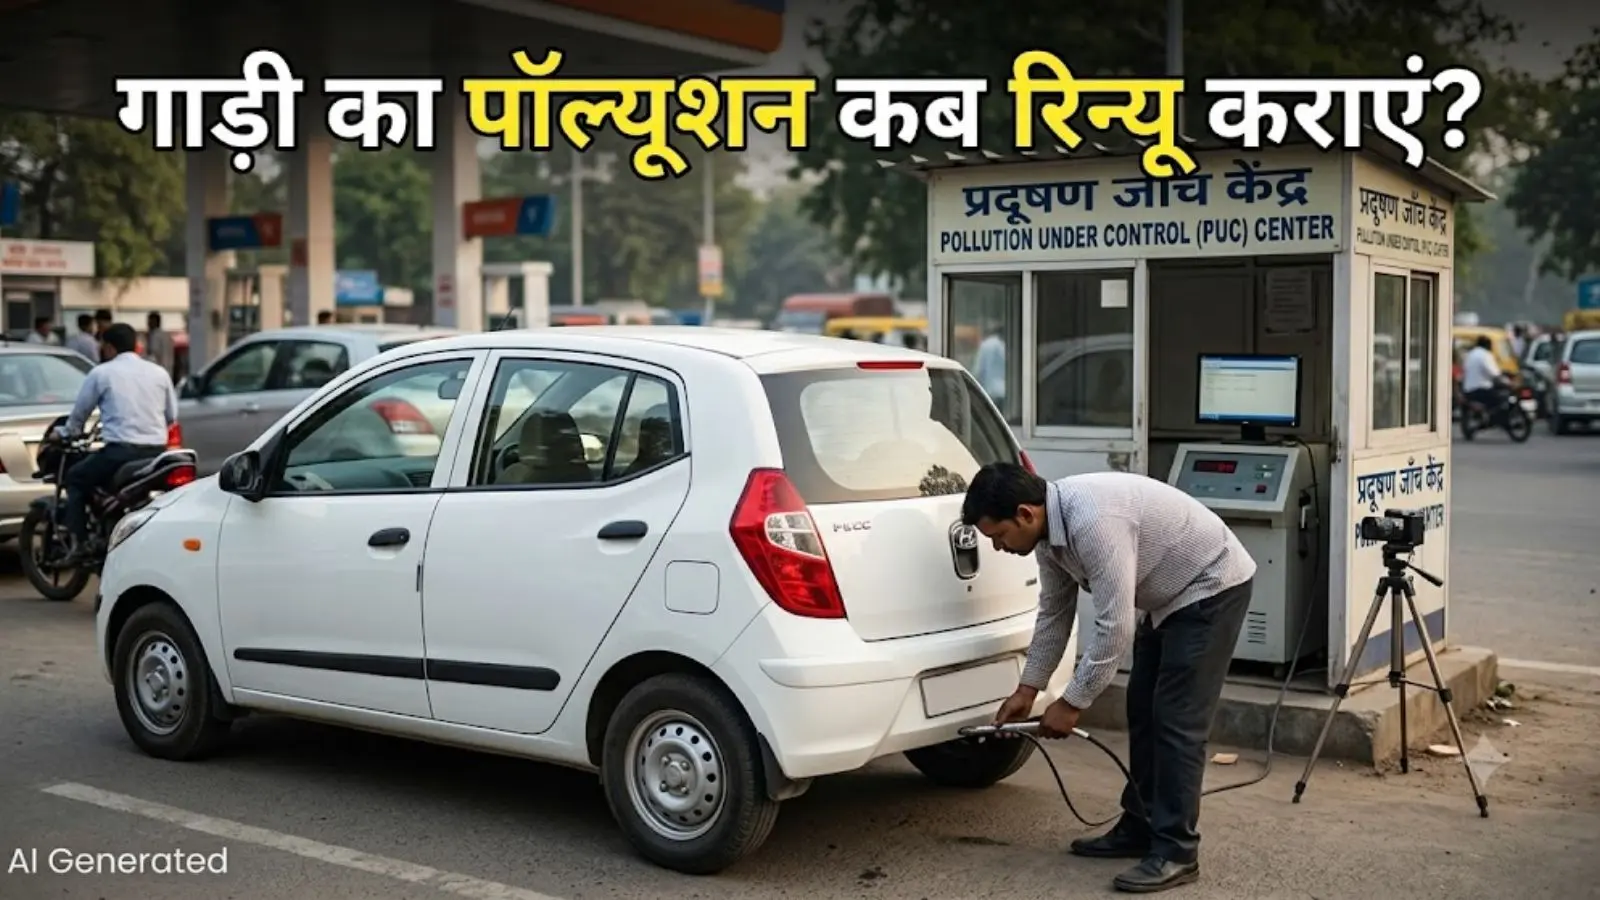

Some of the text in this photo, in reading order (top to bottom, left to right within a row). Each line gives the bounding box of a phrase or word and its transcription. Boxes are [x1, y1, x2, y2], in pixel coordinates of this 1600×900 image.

[962, 180, 1099, 225] प्रदूषण
[1224, 158, 1313, 208] केंद्र
[940, 214, 1335, 253] POLLUTION UNDER CONTROL (PUC) CENTER
